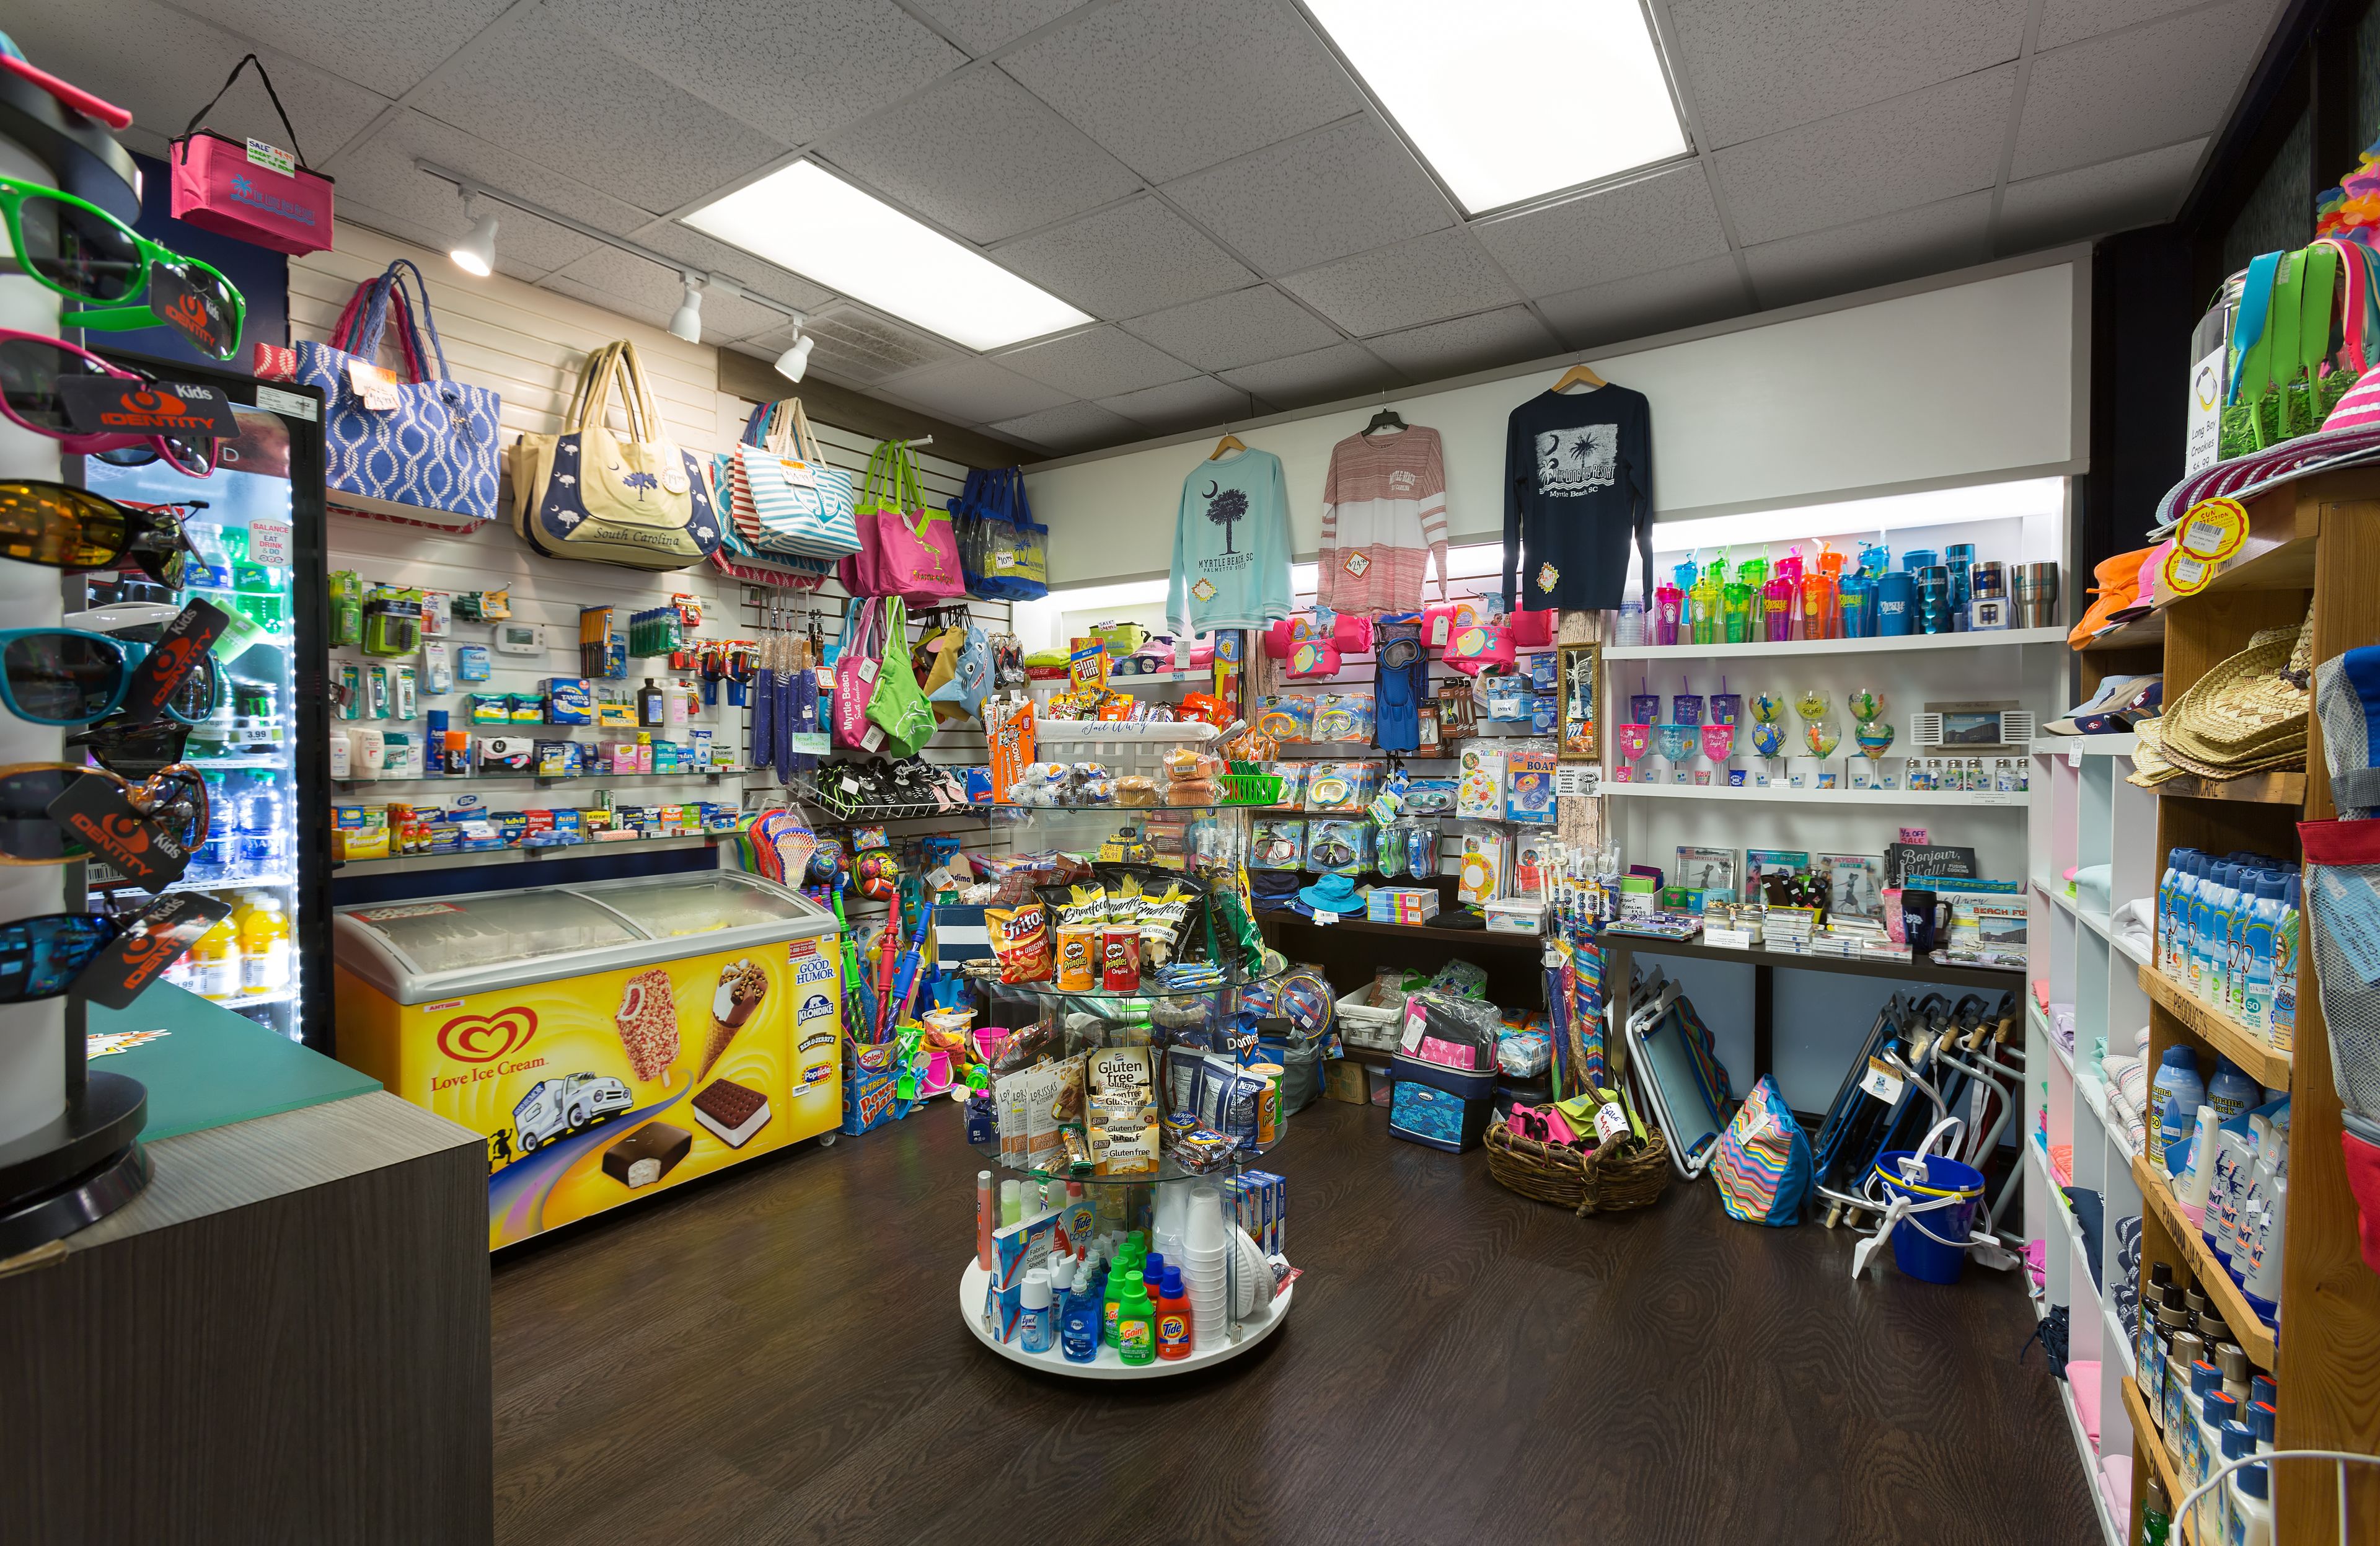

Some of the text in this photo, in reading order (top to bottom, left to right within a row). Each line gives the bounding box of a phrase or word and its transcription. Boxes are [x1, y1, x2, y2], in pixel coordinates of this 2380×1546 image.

[249, 141, 270, 152] SALE
[294, 203, 315, 218] RESORT
[206, 300, 220, 321] Kids
[165, 305, 215, 347] IDENTITY
[175, 384, 213, 400] Kids
[100, 412, 214, 429] IDENTITY
[2192, 418, 2216, 440] Long Bay
[2191, 438, 2215, 457] Croakies
[1556, 465, 1615, 482] THE LONG BAY RESORT
[2200, 509, 2216, 519] SUN
[253, 523, 289, 534] BALANCE
[594, 527, 680, 546] South Carolina
[259, 541, 283, 549] DRINK
[1199, 554, 1254, 568] MYRTLE SC
[1235, 562, 1246, 570] STATE
[171, 607, 197, 635] Kids
[152, 627, 212, 707] IDENTITY
[1074, 658, 1098, 674] slim
[1080, 666, 1100, 681] jim
[842, 671, 850, 699] Beach
[561, 694, 589, 702] TAMPAX
[844, 701, 854, 730] Myrtle
[1802, 707, 1822, 716] Right
[604, 717, 637, 726] NEOSPORIN
[1081, 722, 1109, 735] Sail
[248, 730, 267, 738] 3.99
[1011, 741, 1021, 761] COW
[1527, 761, 1555, 771] BOAT
[504, 817, 526, 825] Advil
[1900, 829, 1910, 837] 1/2
[70, 813, 154, 877] IDENTITY
[152, 833, 181, 859] Kids
[1104, 844, 1119, 852] SALE
[1104, 850, 1118, 859] $6.99
[1902, 849, 1960, 867] Bonjour,
[150, 898, 185, 921] Kids
[1064, 899, 1108, 921] Smartfood
[1137, 901, 1189, 919] Smartfood
[1003, 908, 1044, 940] Fritos
[1148, 927, 1174, 939] CHEDDAR
[1025, 938, 1047, 953] ORIGINAL
[800, 959, 830, 973] GOOD
[1063, 956, 1087, 972] Pringles
[1104, 956, 1127, 971] Pringles
[796, 968, 834, 984] HUMOR
[2246, 1000, 2259, 1010] 50
[2278, 994, 2295, 1008] SUN
[798, 1004, 834, 1024] KLONDIKE
[2174, 992, 2208, 1038] PRODUCTS
[1227, 1032, 1259, 1051] Doritos
[863, 1051, 883, 1064] Splash
[431, 1057, 545, 1091] Love Ice Cream
[804, 1066, 831, 1081] Popsicle
[1098, 1061, 1142, 1074] Gluten
[1107, 1071, 1134, 1084] free
[860, 1076, 888, 1097] X-TREME
[861, 1080, 896, 1108] Power
[1036, 1093, 1054, 1106] KITCHEN
[2208, 1092, 2244, 1108] Panama
[860, 1089, 897, 1128] Splash
[1105, 1098, 1148, 1107] Gluten free
[2213, 1102, 2234, 1115] Jack
[1173, 1110, 1192, 1120] Moon
[1108, 1124, 1148, 1133] Gluten free
[1033, 1133, 1055, 1146] GINGER
[1033, 1138, 1059, 1151] TERIYAKI
[1179, 1139, 1204, 1152] Chocolate
[1109, 1147, 1150, 1157] Gluten free
[1212, 1147, 1227, 1161] Moon
[1203, 1163, 1217, 1174] Moon
[1074, 1216, 1092, 1232] Tide
[1070, 1230, 1093, 1242] to go
[1029, 1244, 1046, 1255] Fabric
[2162, 1207, 2205, 1281] PANAMA JACK
[1026, 1249, 1048, 1263] Softener
[1028, 1258, 1046, 1270] Sheets
[1021, 1315, 1037, 1325] Lysol
[1124, 1328, 1142, 1339] Gain
[1163, 1323, 1182, 1337] Tide
